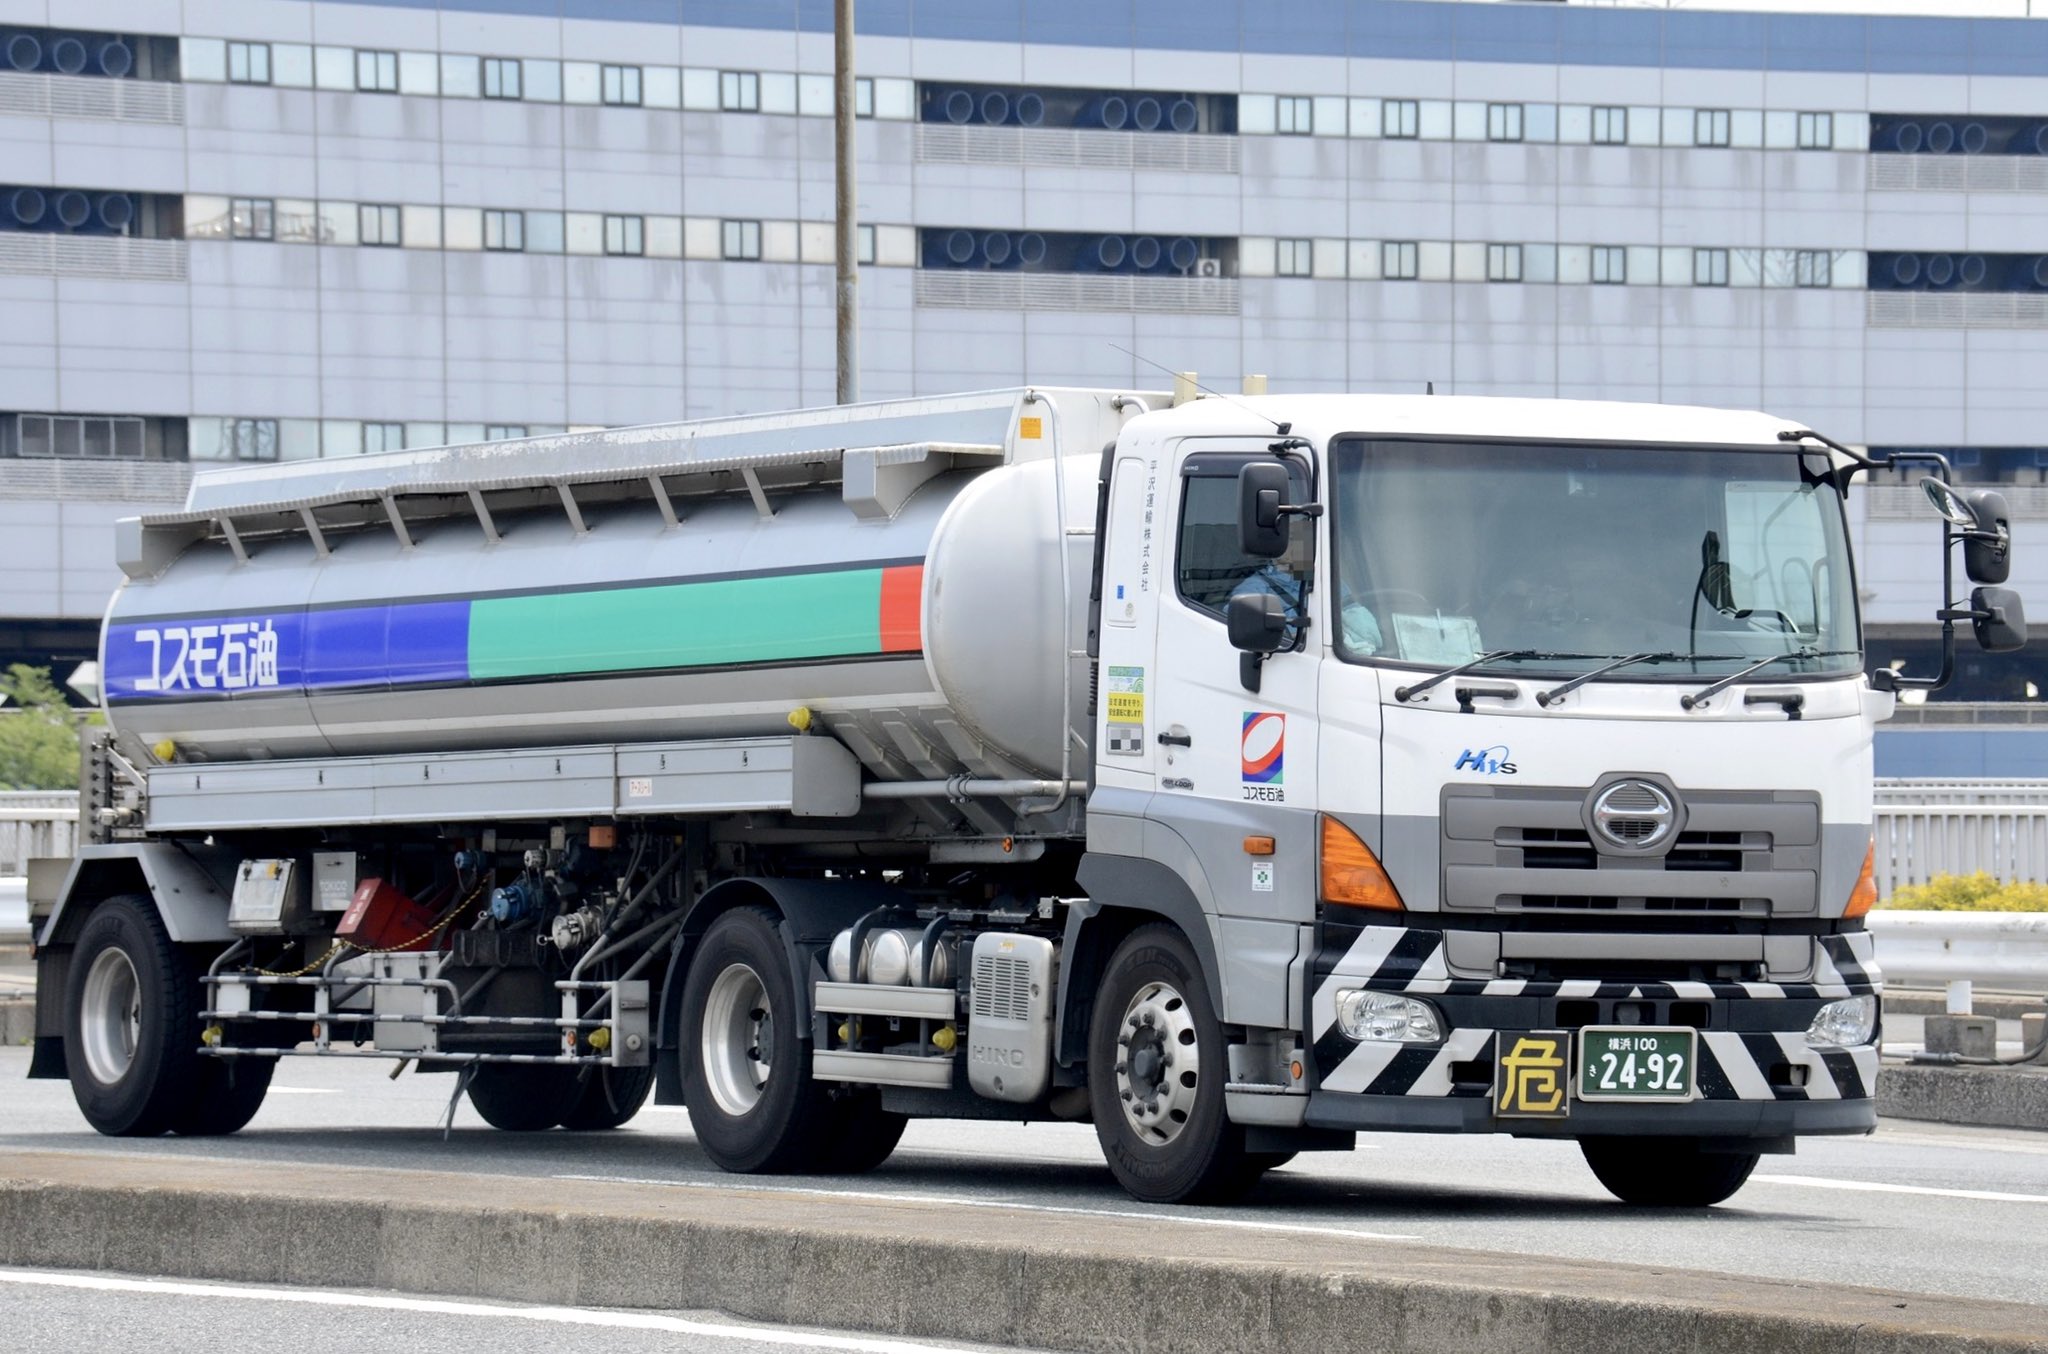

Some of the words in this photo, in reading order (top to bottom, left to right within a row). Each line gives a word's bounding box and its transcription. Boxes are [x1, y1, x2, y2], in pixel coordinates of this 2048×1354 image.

[134, 619, 279, 691] コスモ石油
[1454, 748, 1518, 775] Hits
[1243, 786, 1284, 802] コスモ石油
[972, 1044, 1024, 1068] HINO
[1608, 1037, 1631, 1051] 横浜
[1634, 1037, 1658, 1051] 100
[1500, 1037, 1564, 1112] 危
[1588, 1064, 1598, 1078] き
[1600, 1052, 1684, 1090] 24-92
